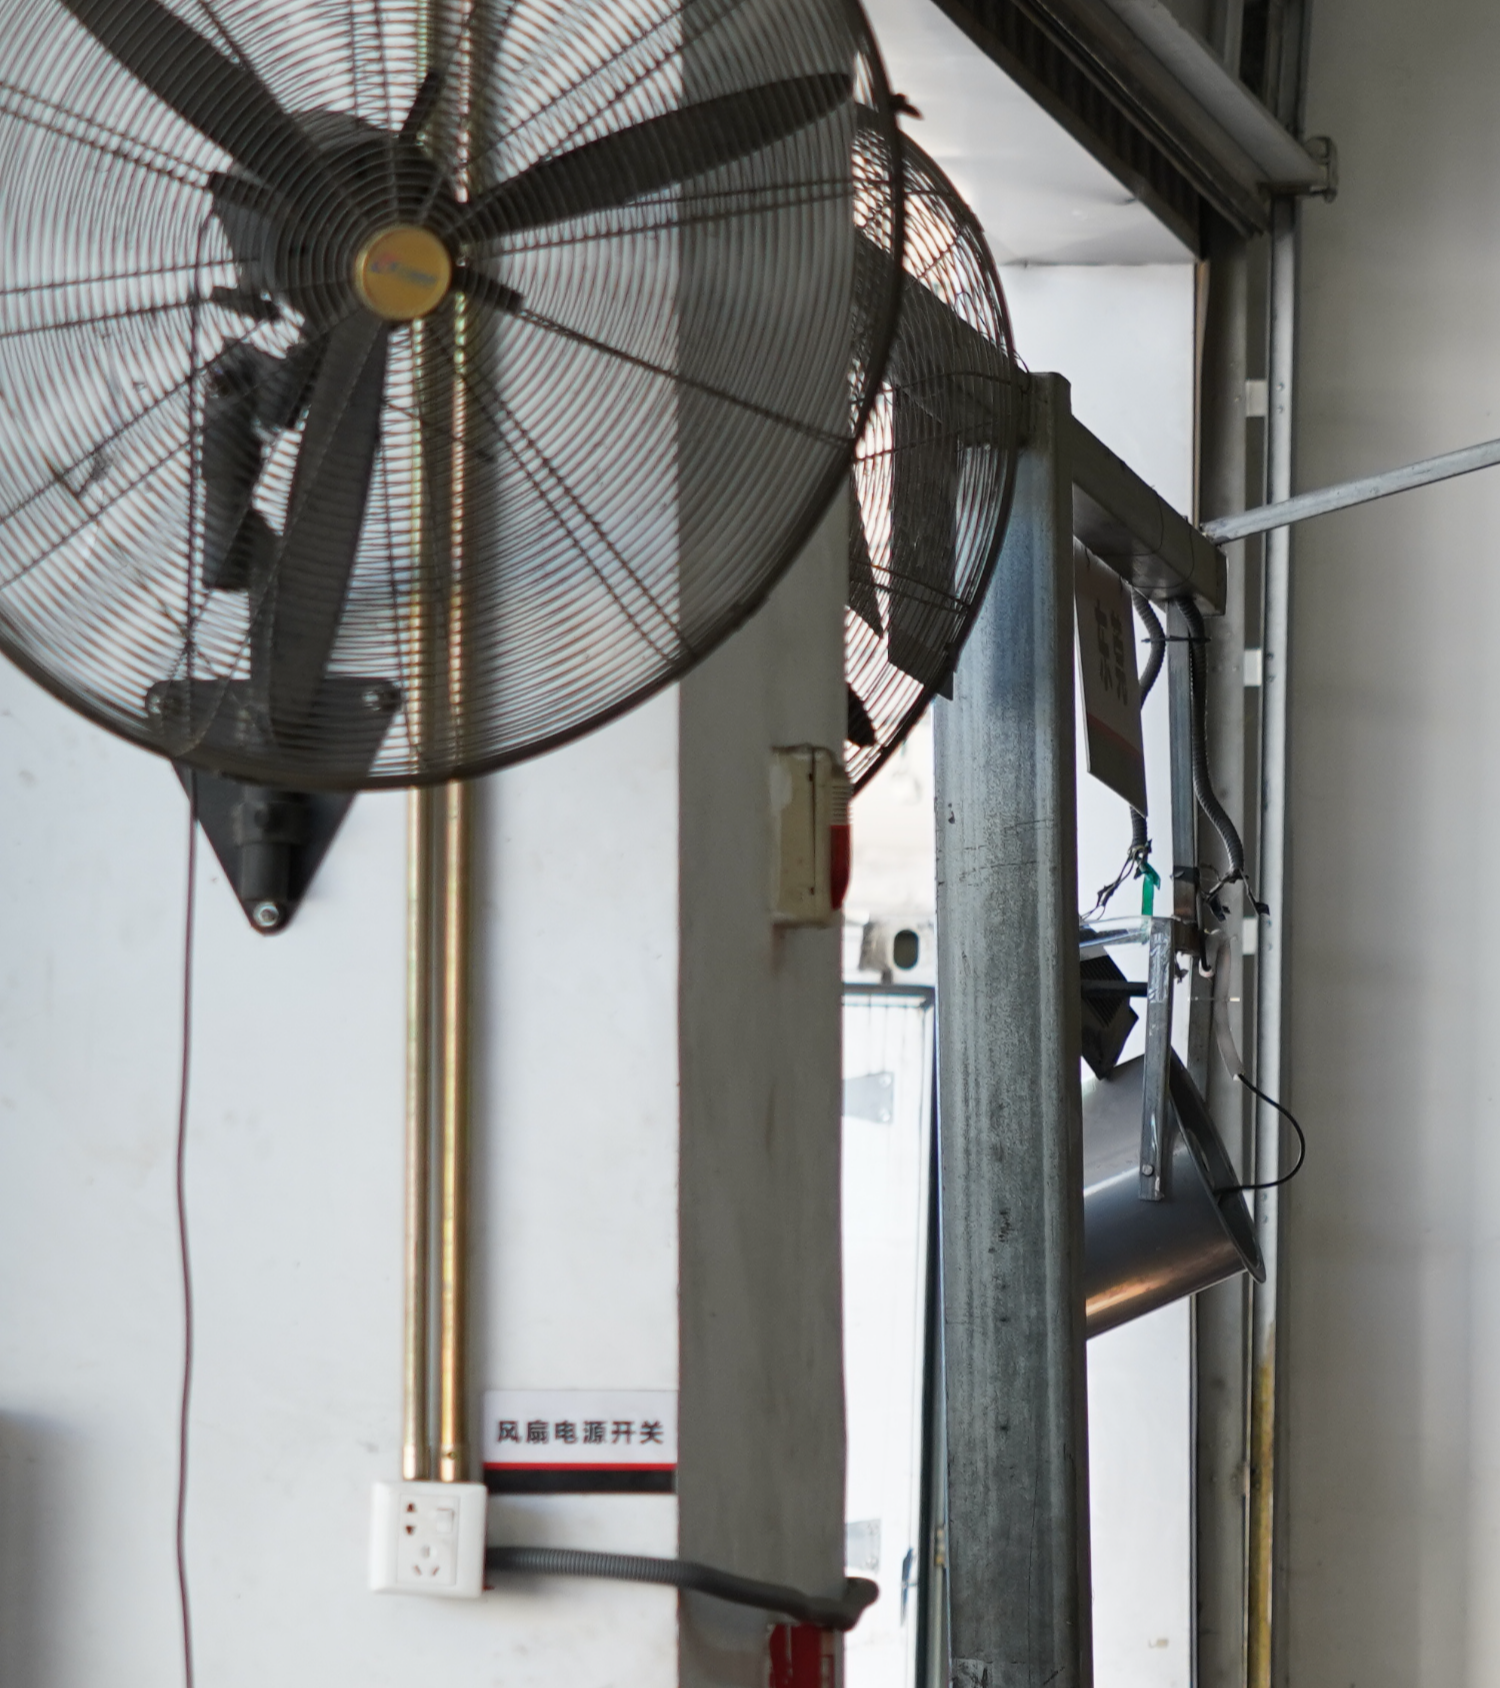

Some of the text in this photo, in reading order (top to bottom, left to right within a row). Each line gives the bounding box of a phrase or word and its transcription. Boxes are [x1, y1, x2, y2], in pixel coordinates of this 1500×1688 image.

[496, 1419, 666, 1445] 风扇电源开关
